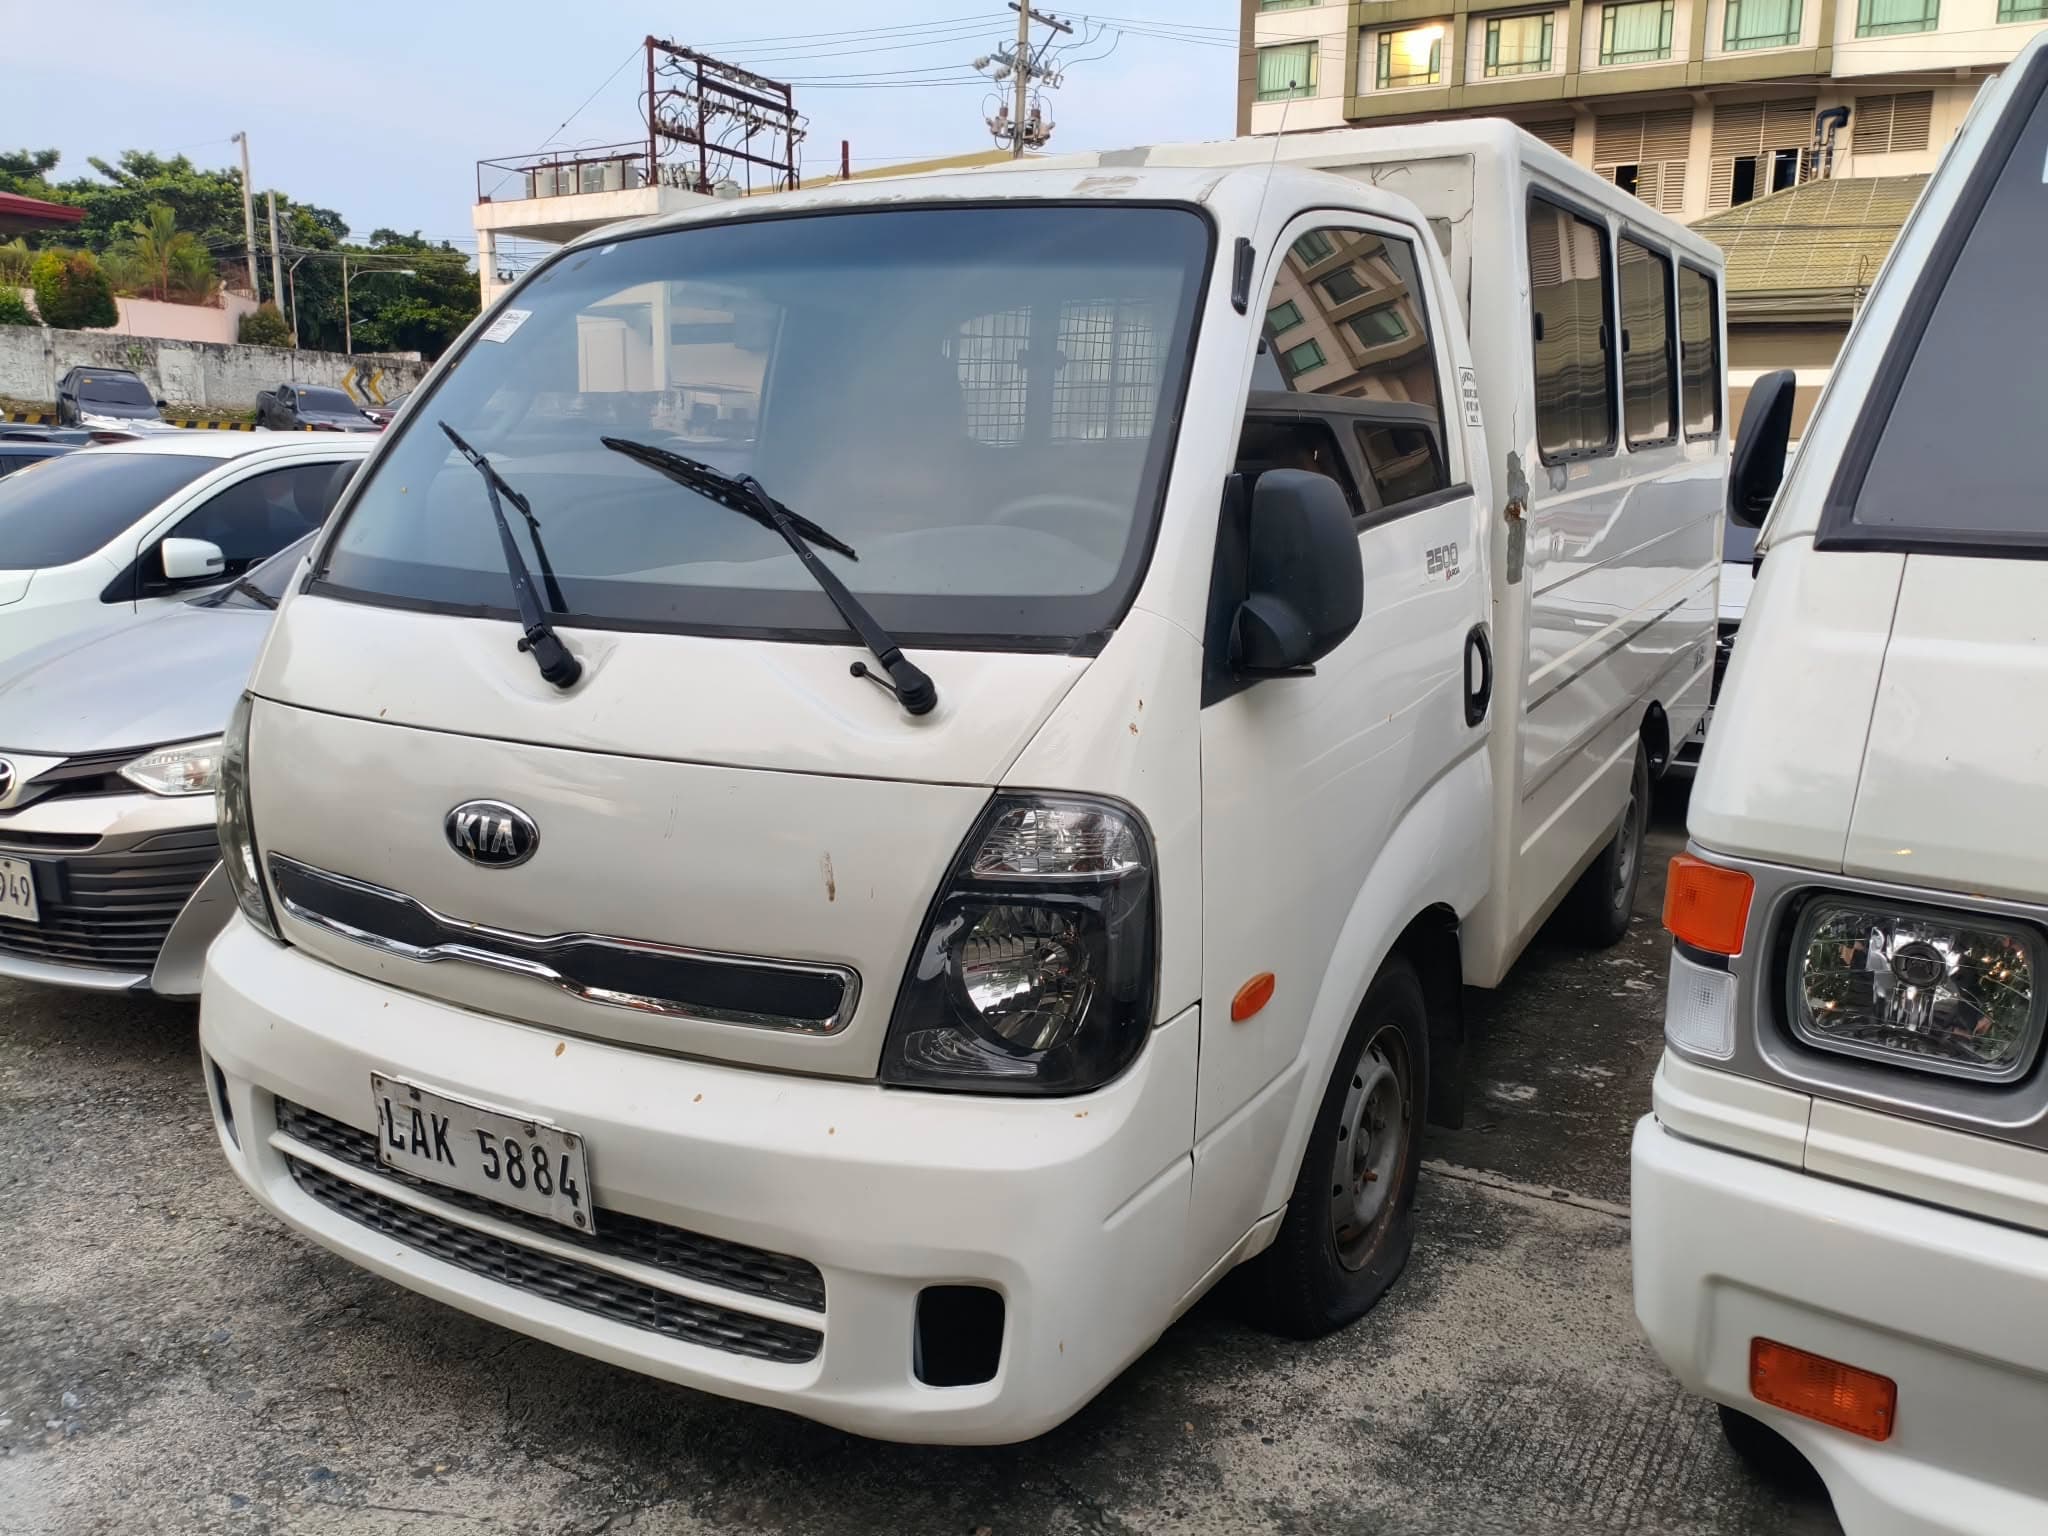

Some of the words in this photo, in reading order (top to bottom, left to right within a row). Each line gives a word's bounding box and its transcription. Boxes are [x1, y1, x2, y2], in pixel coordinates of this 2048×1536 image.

[91, 350, 125, 366] ONE
[127, 351, 159, 367] WAY
[1425, 542, 1459, 575] 2500
[455, 811, 518, 856] KIA
[383, 1096, 456, 1167] LAK
[475, 1127, 581, 1207] 5884
